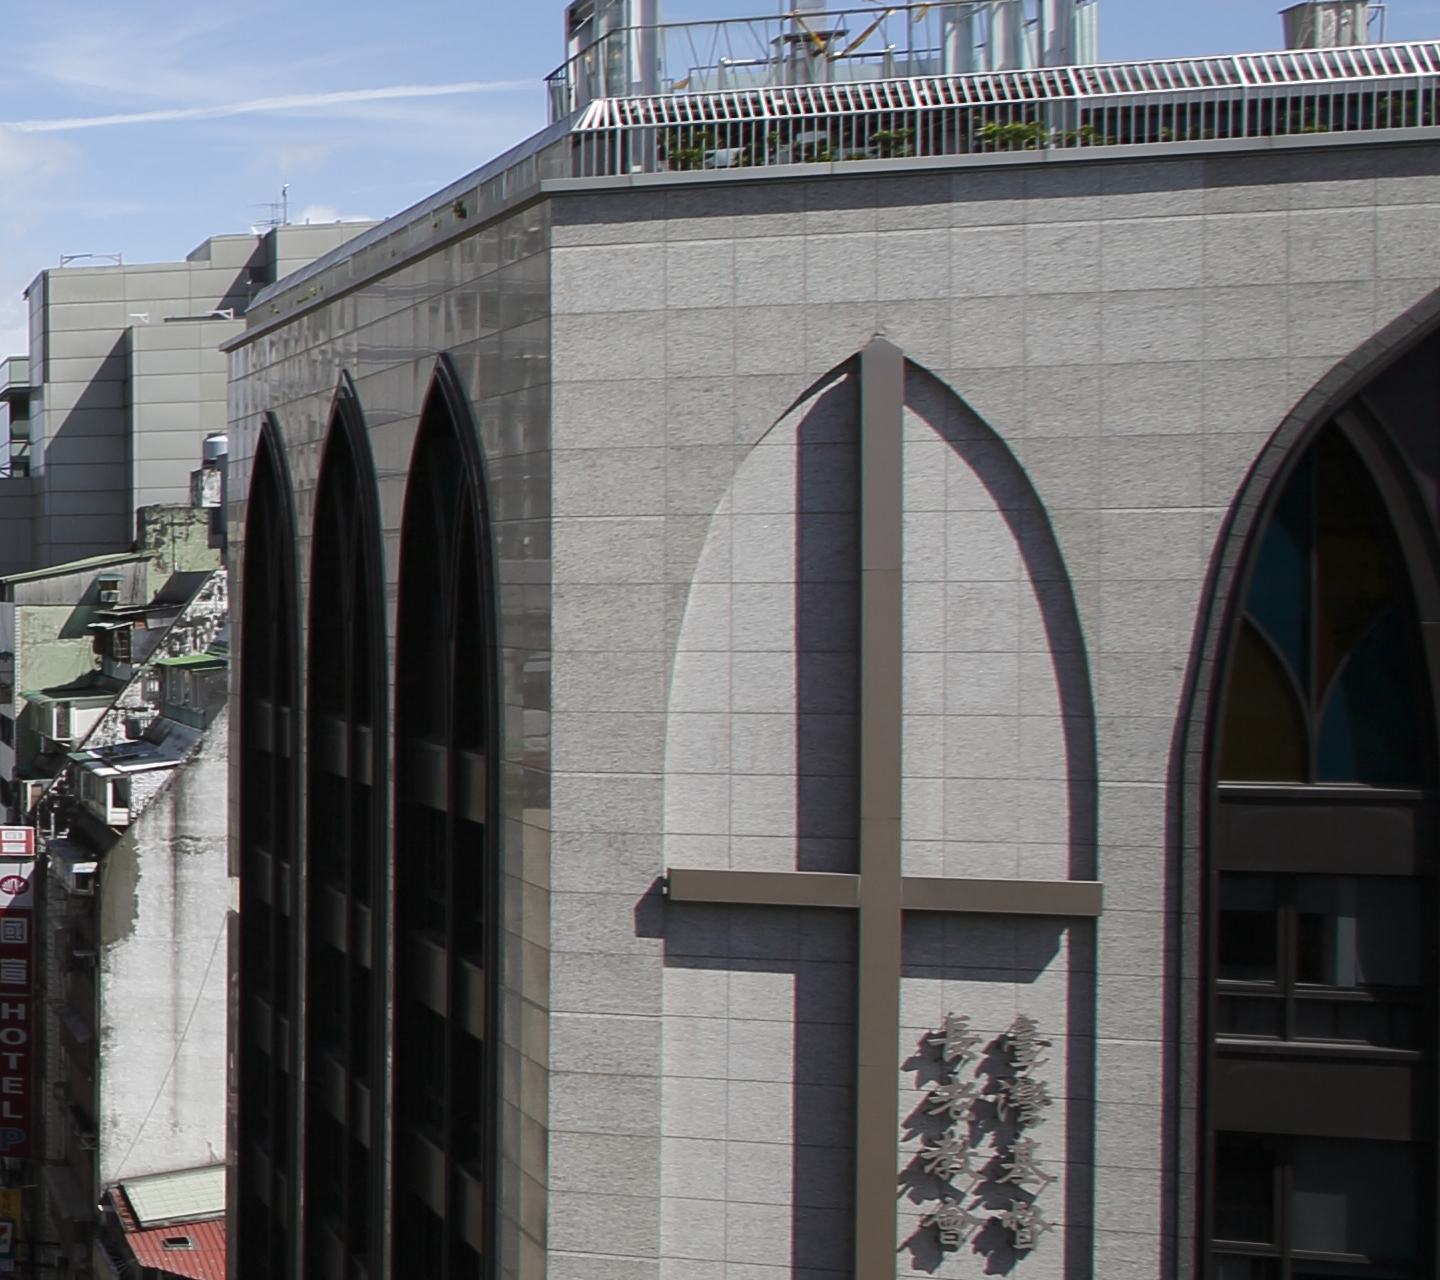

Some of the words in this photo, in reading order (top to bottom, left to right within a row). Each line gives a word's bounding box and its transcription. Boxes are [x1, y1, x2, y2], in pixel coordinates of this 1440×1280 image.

[0, 1001, 28, 1120] HOTEL
[0, 1126, 26, 1152] P
[923, 1011, 984, 1253] 長老教會
[996, 1012, 1057, 1253] 臺灣基督
